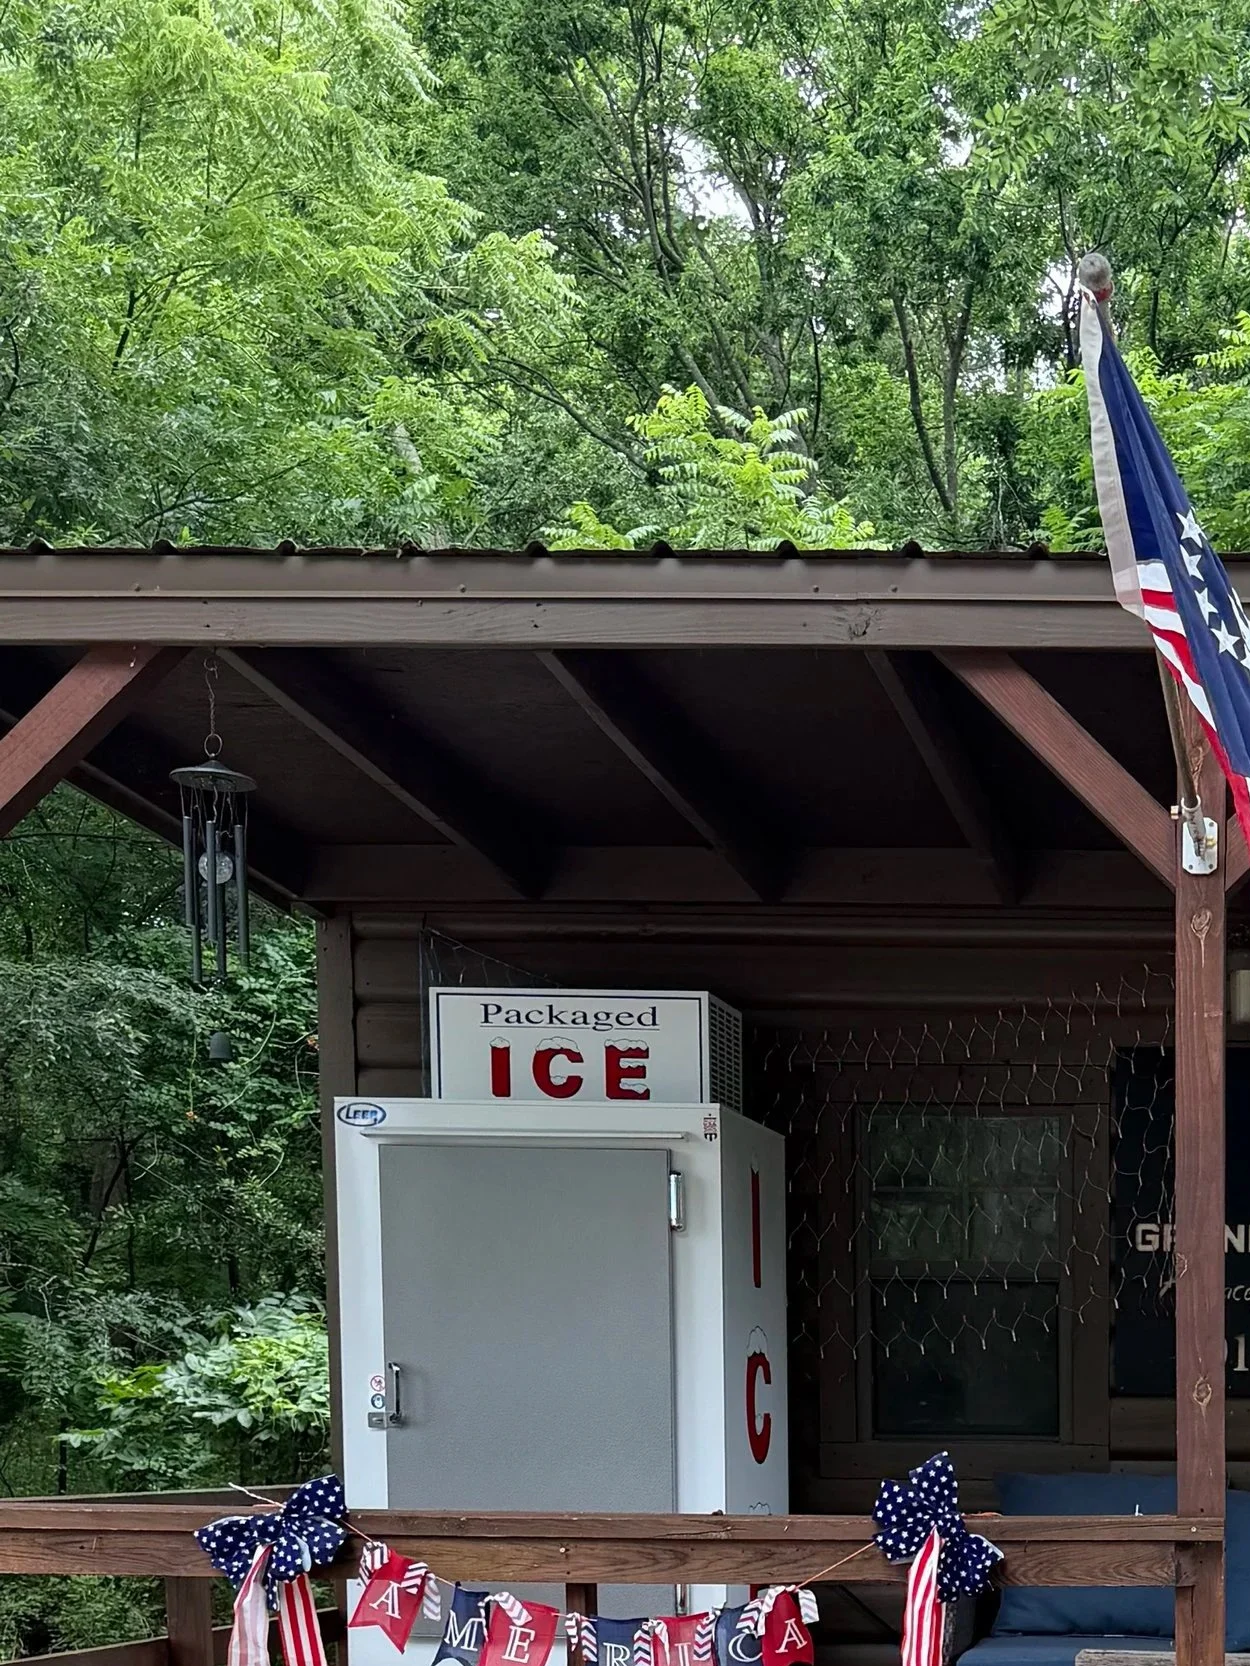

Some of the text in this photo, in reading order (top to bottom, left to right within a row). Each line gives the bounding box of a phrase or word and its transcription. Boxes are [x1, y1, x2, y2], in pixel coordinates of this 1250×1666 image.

[480, 1003, 660, 1032] Packaged
[489, 1036, 651, 1100] ICE
[745, 1152, 772, 1465] IC
